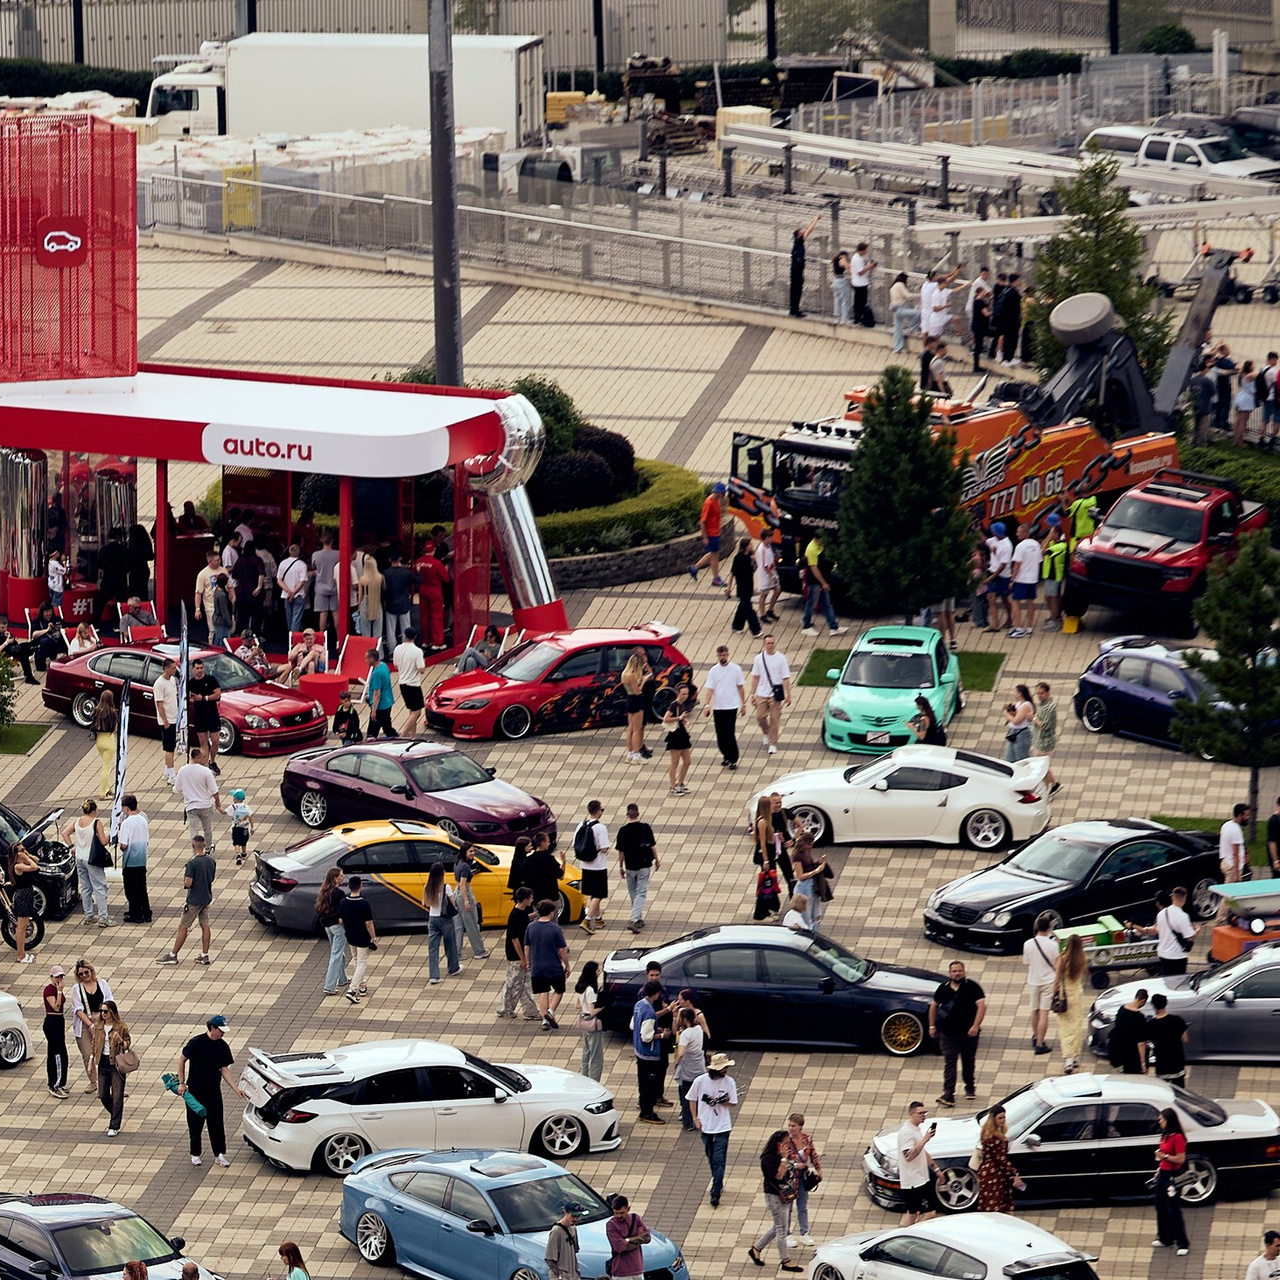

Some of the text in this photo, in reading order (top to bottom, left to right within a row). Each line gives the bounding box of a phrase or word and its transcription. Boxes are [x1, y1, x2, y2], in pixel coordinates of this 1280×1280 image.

[222, 437, 312, 462] auto.ru
[989, 468, 1064, 519] 777 00 66
[73, 598, 94, 615] #1
